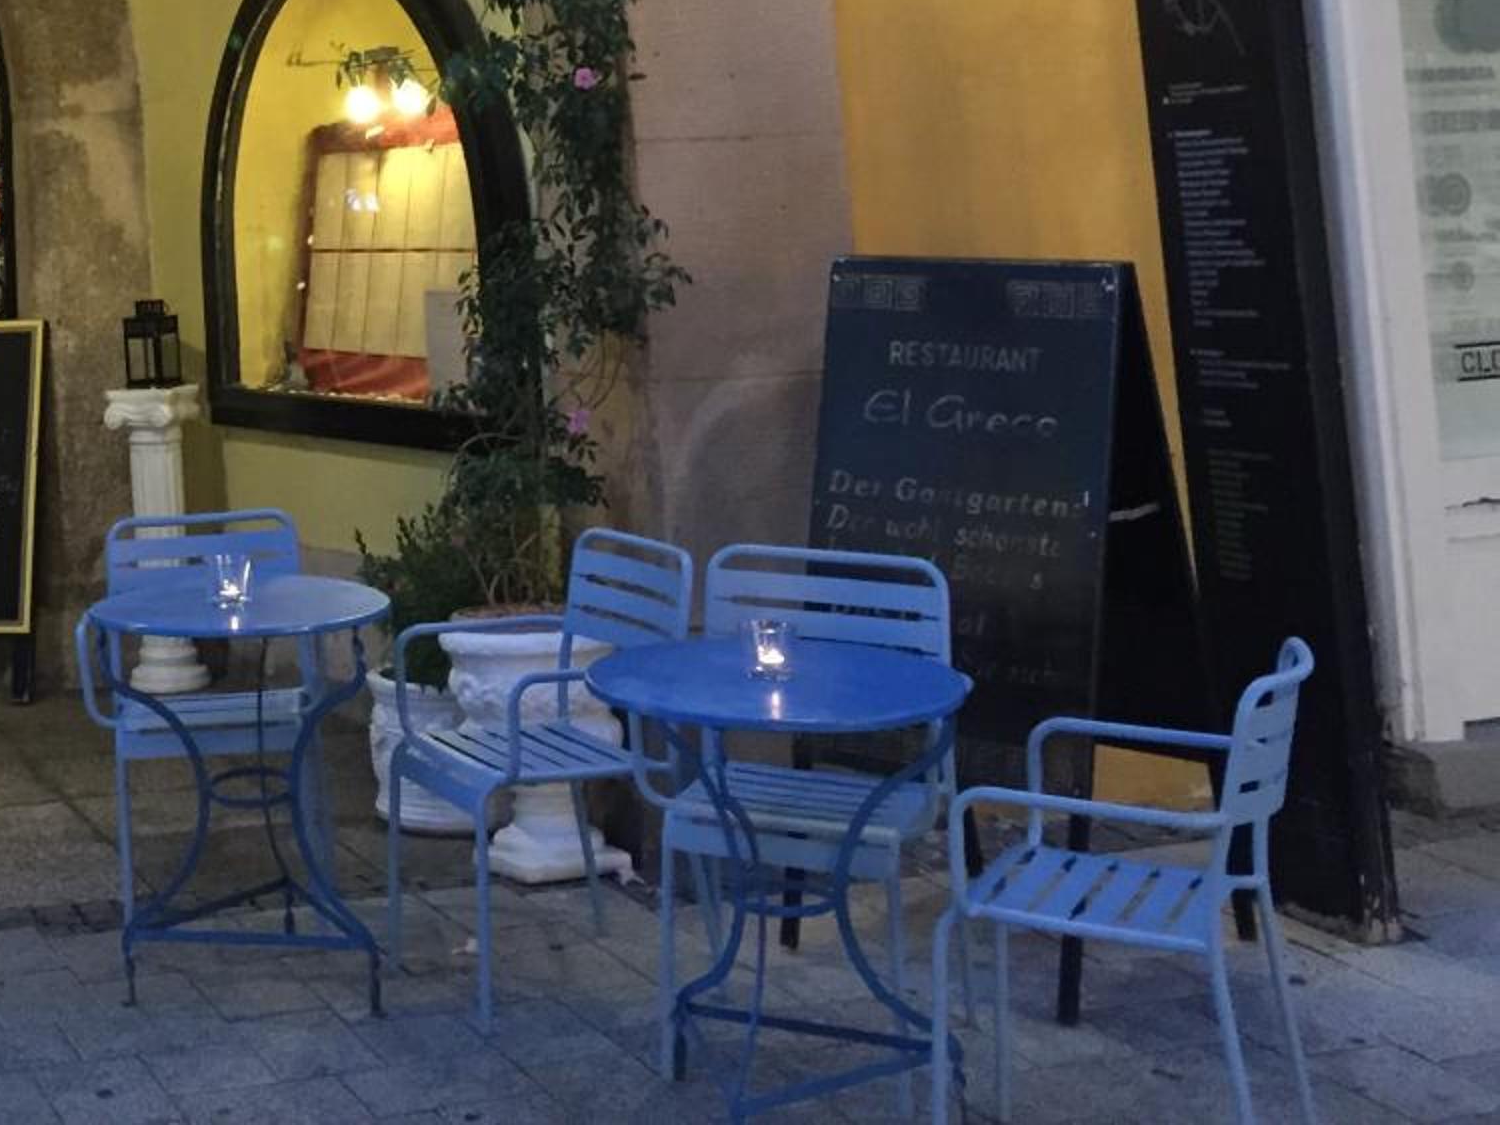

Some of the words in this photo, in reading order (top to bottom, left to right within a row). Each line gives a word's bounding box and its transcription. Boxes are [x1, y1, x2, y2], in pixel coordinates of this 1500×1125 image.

[888, 340, 1043, 373] RESTAURANT
[862, 386, 914, 426] El
[925, 393, 1062, 439] Greco
